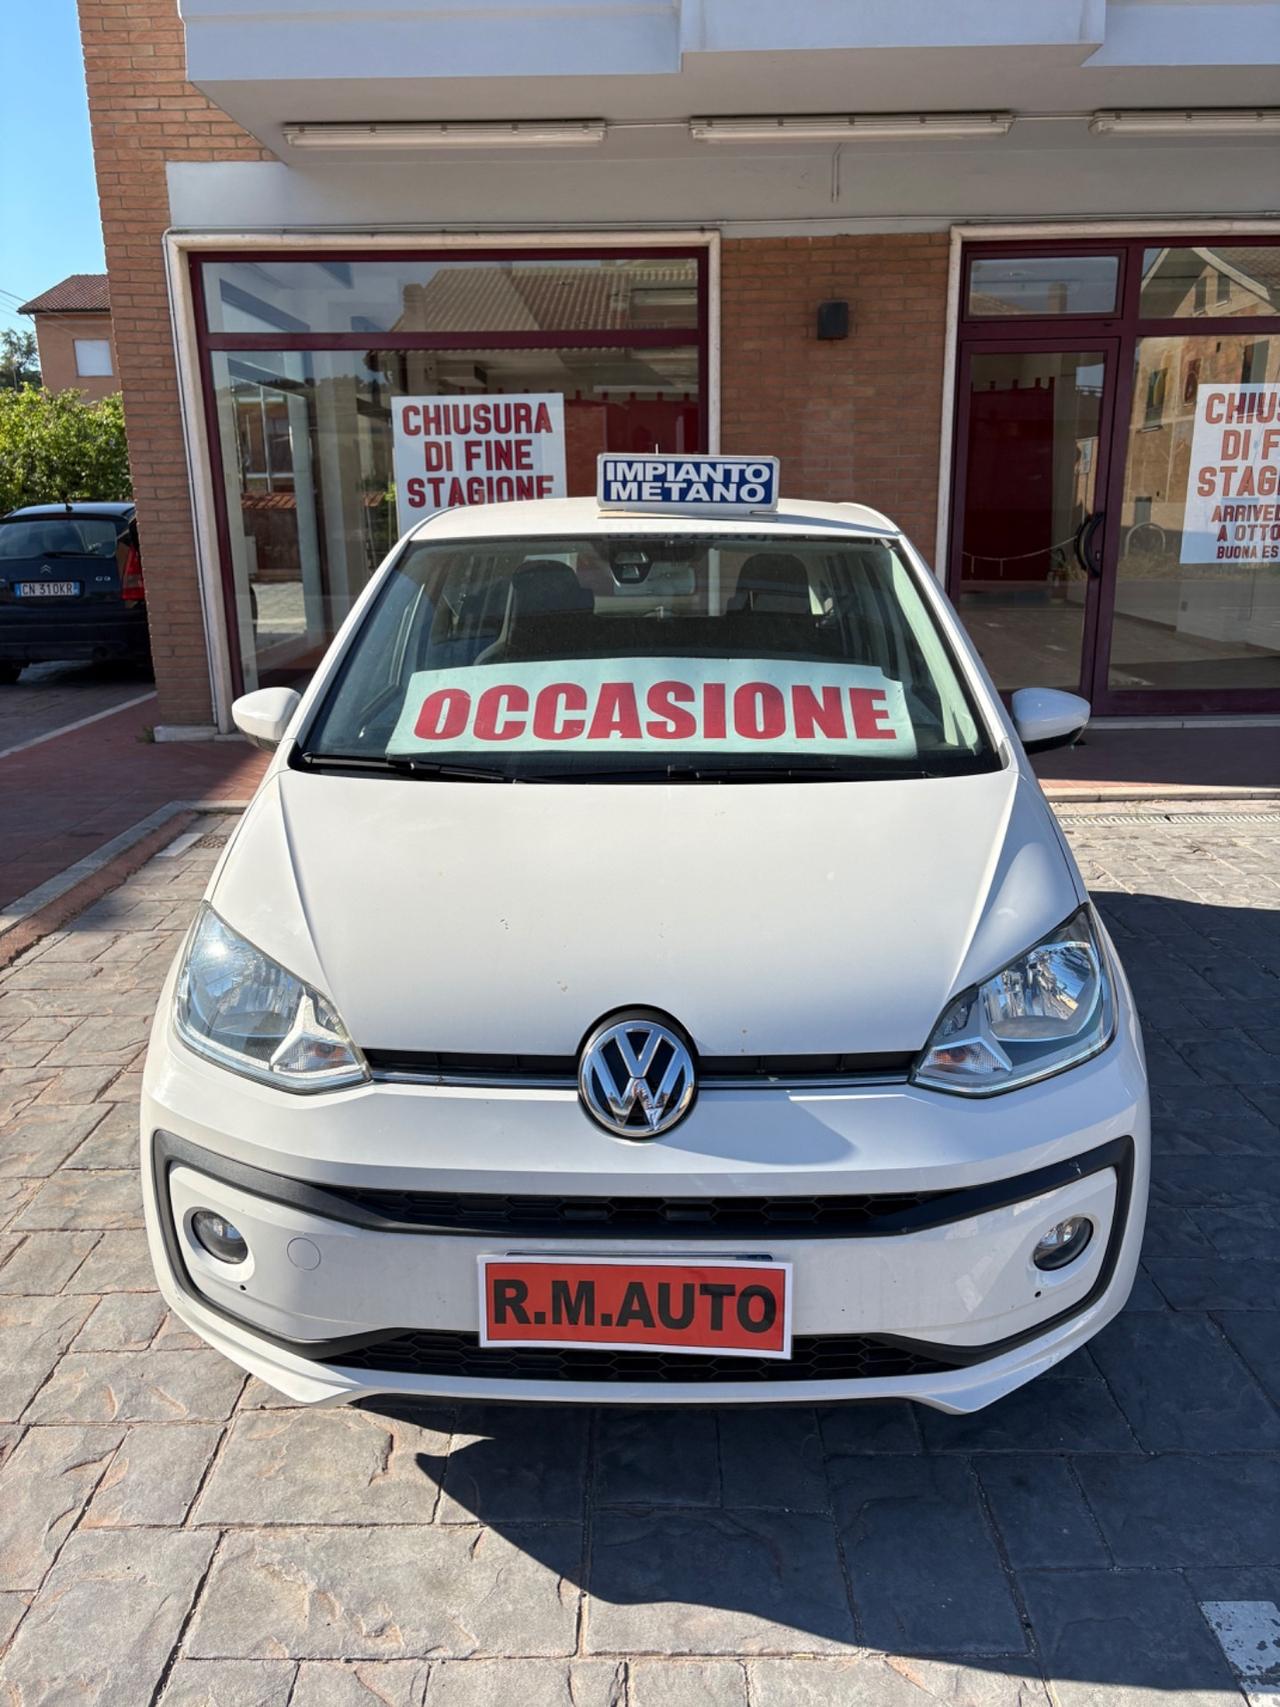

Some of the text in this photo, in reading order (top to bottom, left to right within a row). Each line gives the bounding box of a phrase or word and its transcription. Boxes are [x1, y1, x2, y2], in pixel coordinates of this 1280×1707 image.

[402, 402, 553, 436] CHIUSURA
[1205, 392, 1280, 425] CHIU
[424, 439, 533, 472] DI FINE
[1220, 429, 1251, 461] DI
[606, 462, 771, 483] IMPIANTO
[407, 475, 554, 508] STAGIONE
[610, 482, 765, 502] METANO
[1217, 524, 1280, 542] A OTTO
[1216, 545, 1279, 559] BUONA ES
[22, 583, 36, 595] CN
[413, 681, 897, 741] OCCASIONE
[493, 1279, 777, 1333] R.M.AUTO
